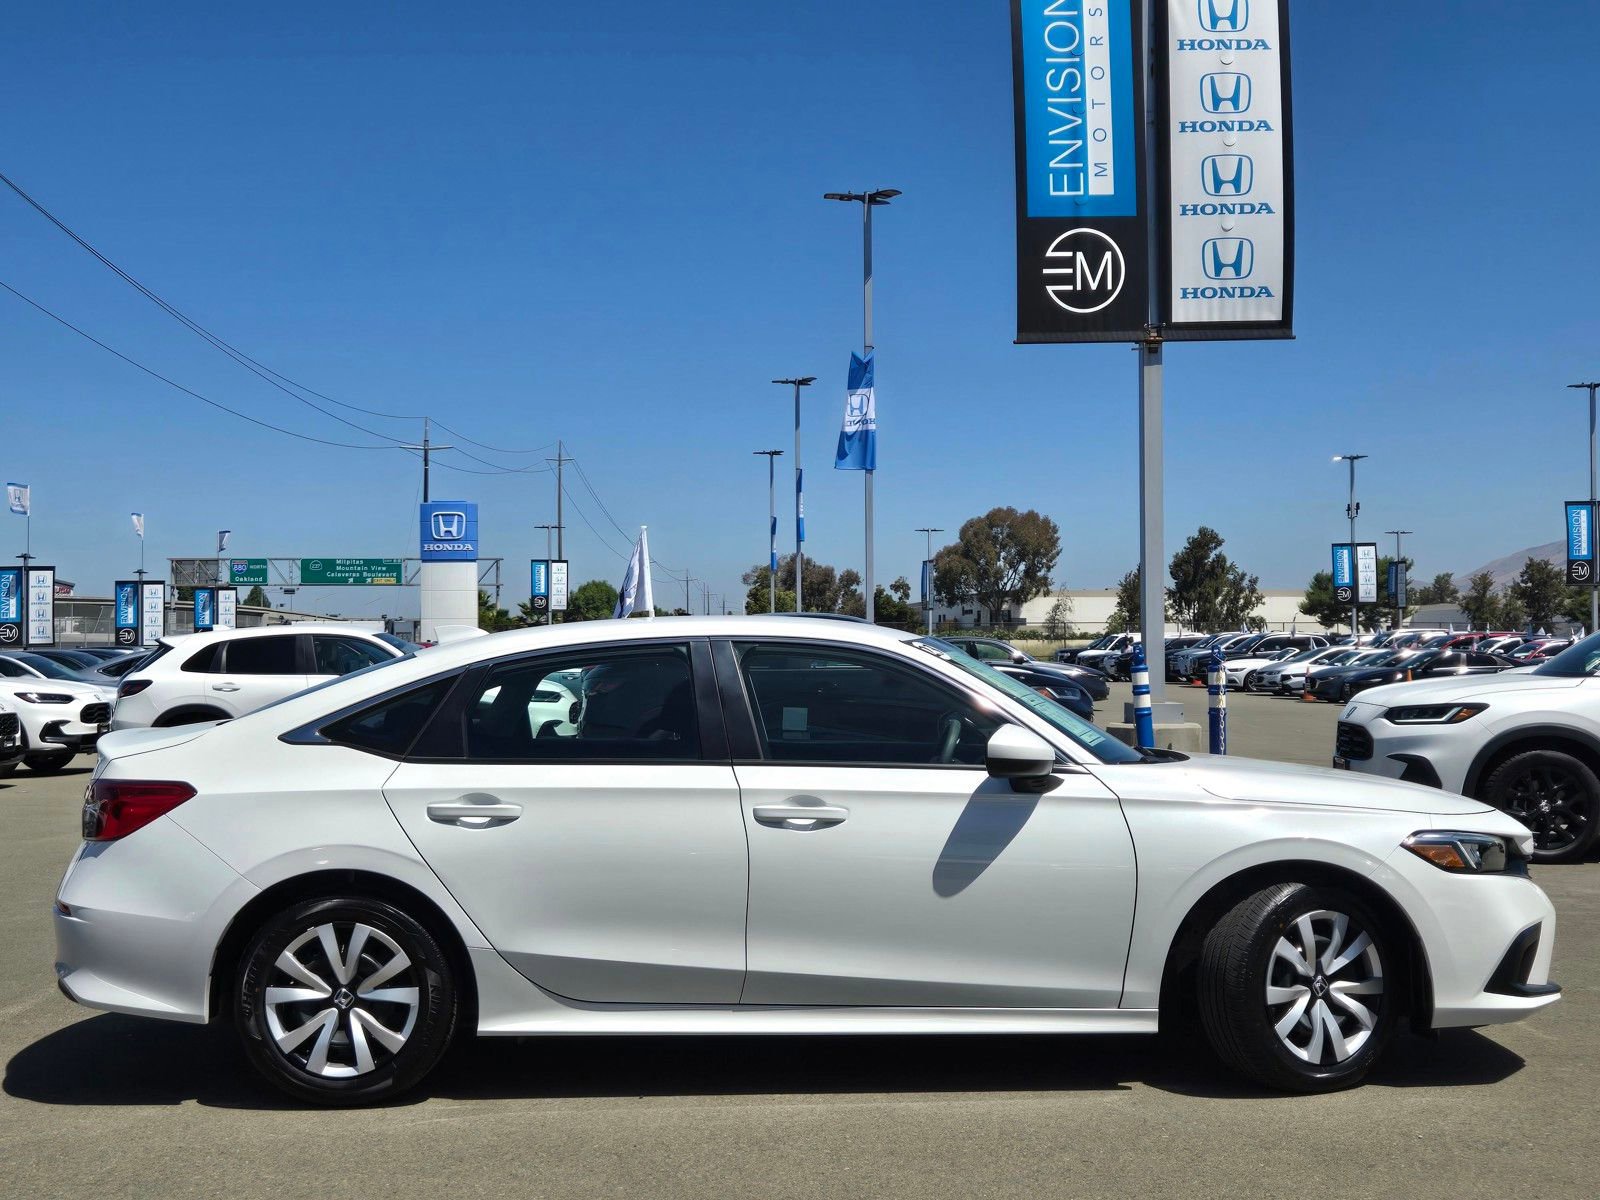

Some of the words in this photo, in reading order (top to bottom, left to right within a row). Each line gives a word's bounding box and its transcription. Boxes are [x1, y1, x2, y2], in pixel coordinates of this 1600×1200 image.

[1177, 38, 1272, 51] HONDA
[1044, 0, 1084, 197] ENVISION
[1089, 7, 1108, 177] MOTORS
[1178, 119, 1274, 133] HONDA
[1179, 202, 1275, 216] HONDA
[1180, 286, 1275, 299] HONDA
[1572, 509, 1581, 556] ENVISION
[423, 543, 474, 551] HONDA
[1, 574, 10, 619] ENVISION
